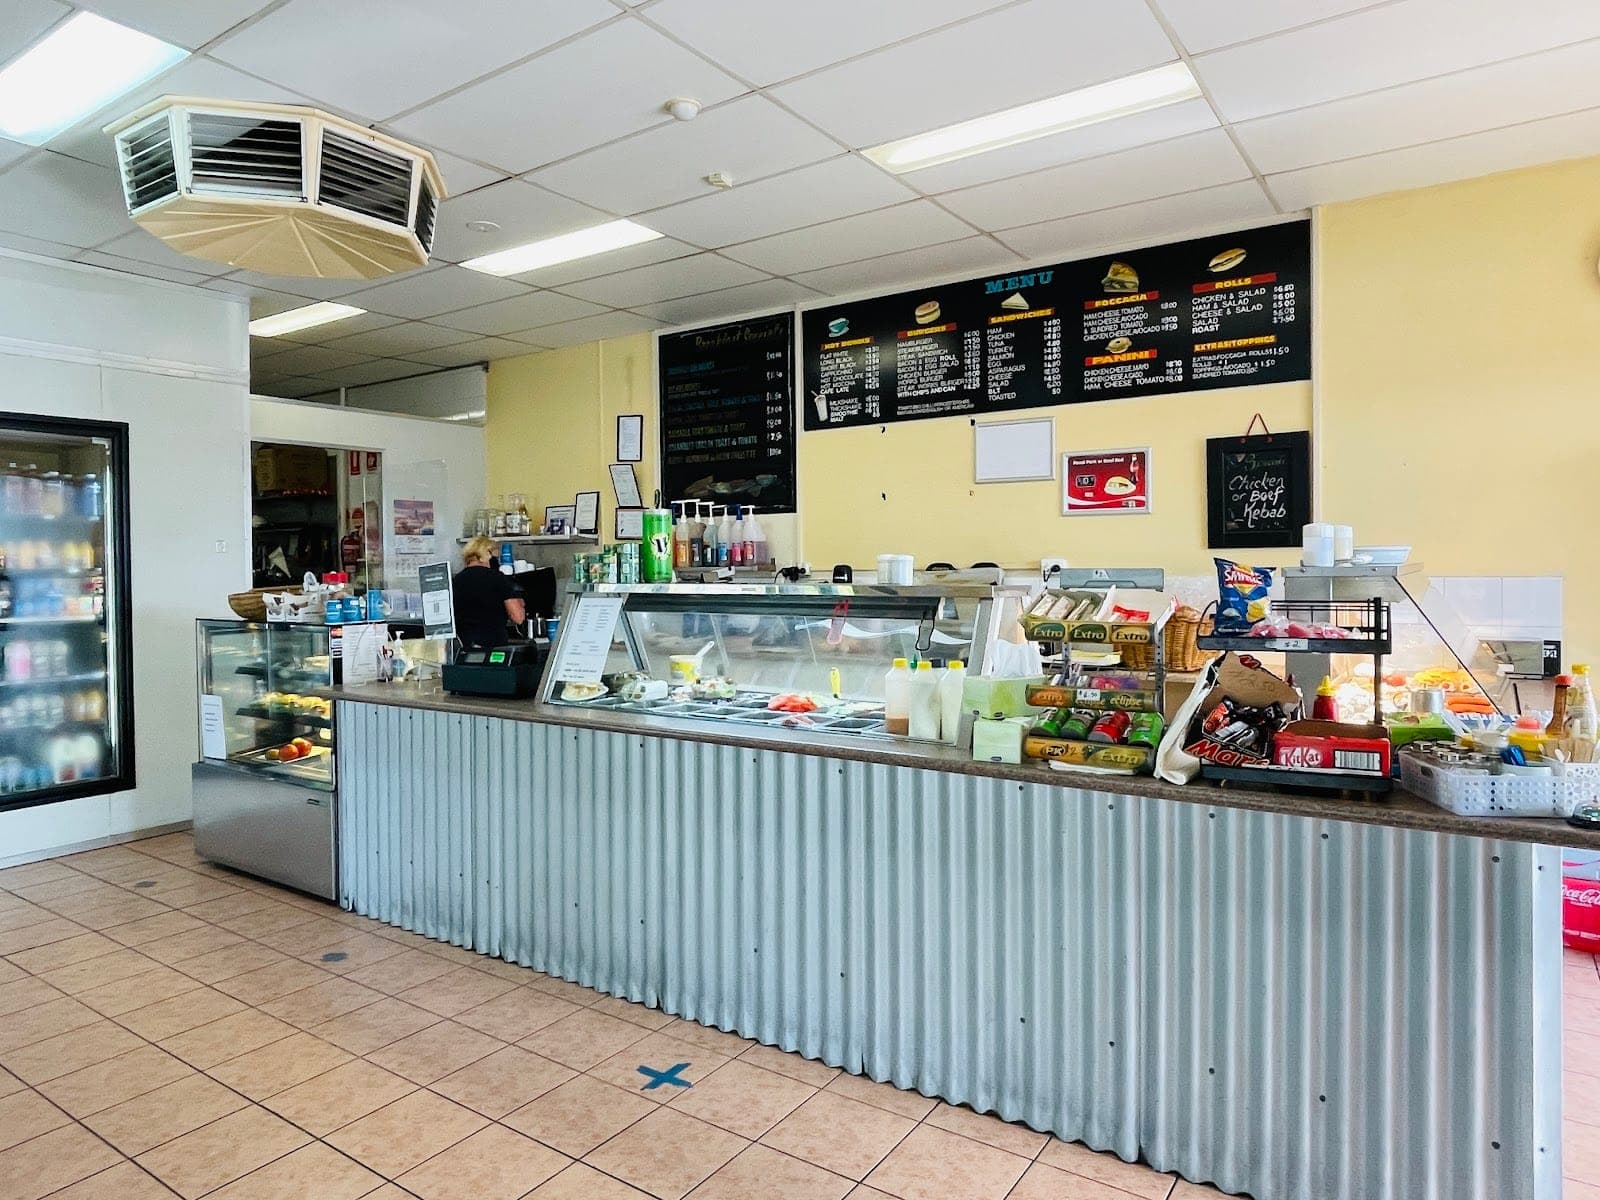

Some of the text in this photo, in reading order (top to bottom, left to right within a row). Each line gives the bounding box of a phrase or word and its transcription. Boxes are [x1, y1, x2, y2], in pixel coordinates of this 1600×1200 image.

[985, 271, 1054, 294] MENU
[1215, 278, 1252, 289] ROLLS
[1095, 294, 1147, 308] FOCCACIA
[1192, 294, 1226, 305] CHICKEN
[1238, 288, 1266, 298] SALAD
[1192, 304, 1210, 312] HAM
[1222, 298, 1249, 308] SALAD
[1121, 306, 1144, 315] TOMATO
[1192, 309, 1224, 319] CHEESE
[1236, 304, 1263, 314] SALAD
[1090, 325, 1118, 334] SUNDRIED
[1121, 321, 1143, 329] TOMATO
[1192, 318, 1218, 327] SALAD
[1133, 325, 1160, 335] AVOCADO
[1192, 324, 1220, 334] ROAST
[987, 332, 1015, 341] CHICKEN
[897, 338, 933, 348] HAMBURGER
[988, 340, 1005, 348] TUNA
[897, 349, 948, 361] STEAK SANDWICH
[988, 346, 1013, 355] TURKEY
[988, 353, 1014, 361] SALMON
[1092, 351, 1149, 365] PANINI
[897, 366, 917, 374] BACON
[898, 368, 948, 380] CHICKEN BURGER
[988, 364, 1026, 375] ASPARAGUS
[832, 372, 864, 382] CHOCOLATE
[920, 375, 943, 383] BURGER
[988, 372, 1013, 382] CHEESE
[1104, 380, 1132, 388] CHEESE
[1136, 376, 1164, 385] TOMATO
[988, 380, 1009, 388] SALAD
[988, 392, 1016, 401] TOASTED
[1229, 472, 1285, 490] Chicken
[1232, 493, 1247, 502] or
[1244, 502, 1286, 528] Kebab
[1034, 627, 1064, 638] Extra
[1073, 629, 1105, 639] Extra
[1116, 632, 1148, 641] Extra
[1184, 738, 1271, 766] Mars
[1280, 746, 1323, 768] KitKat
[1101, 753, 1138, 765] Extra
